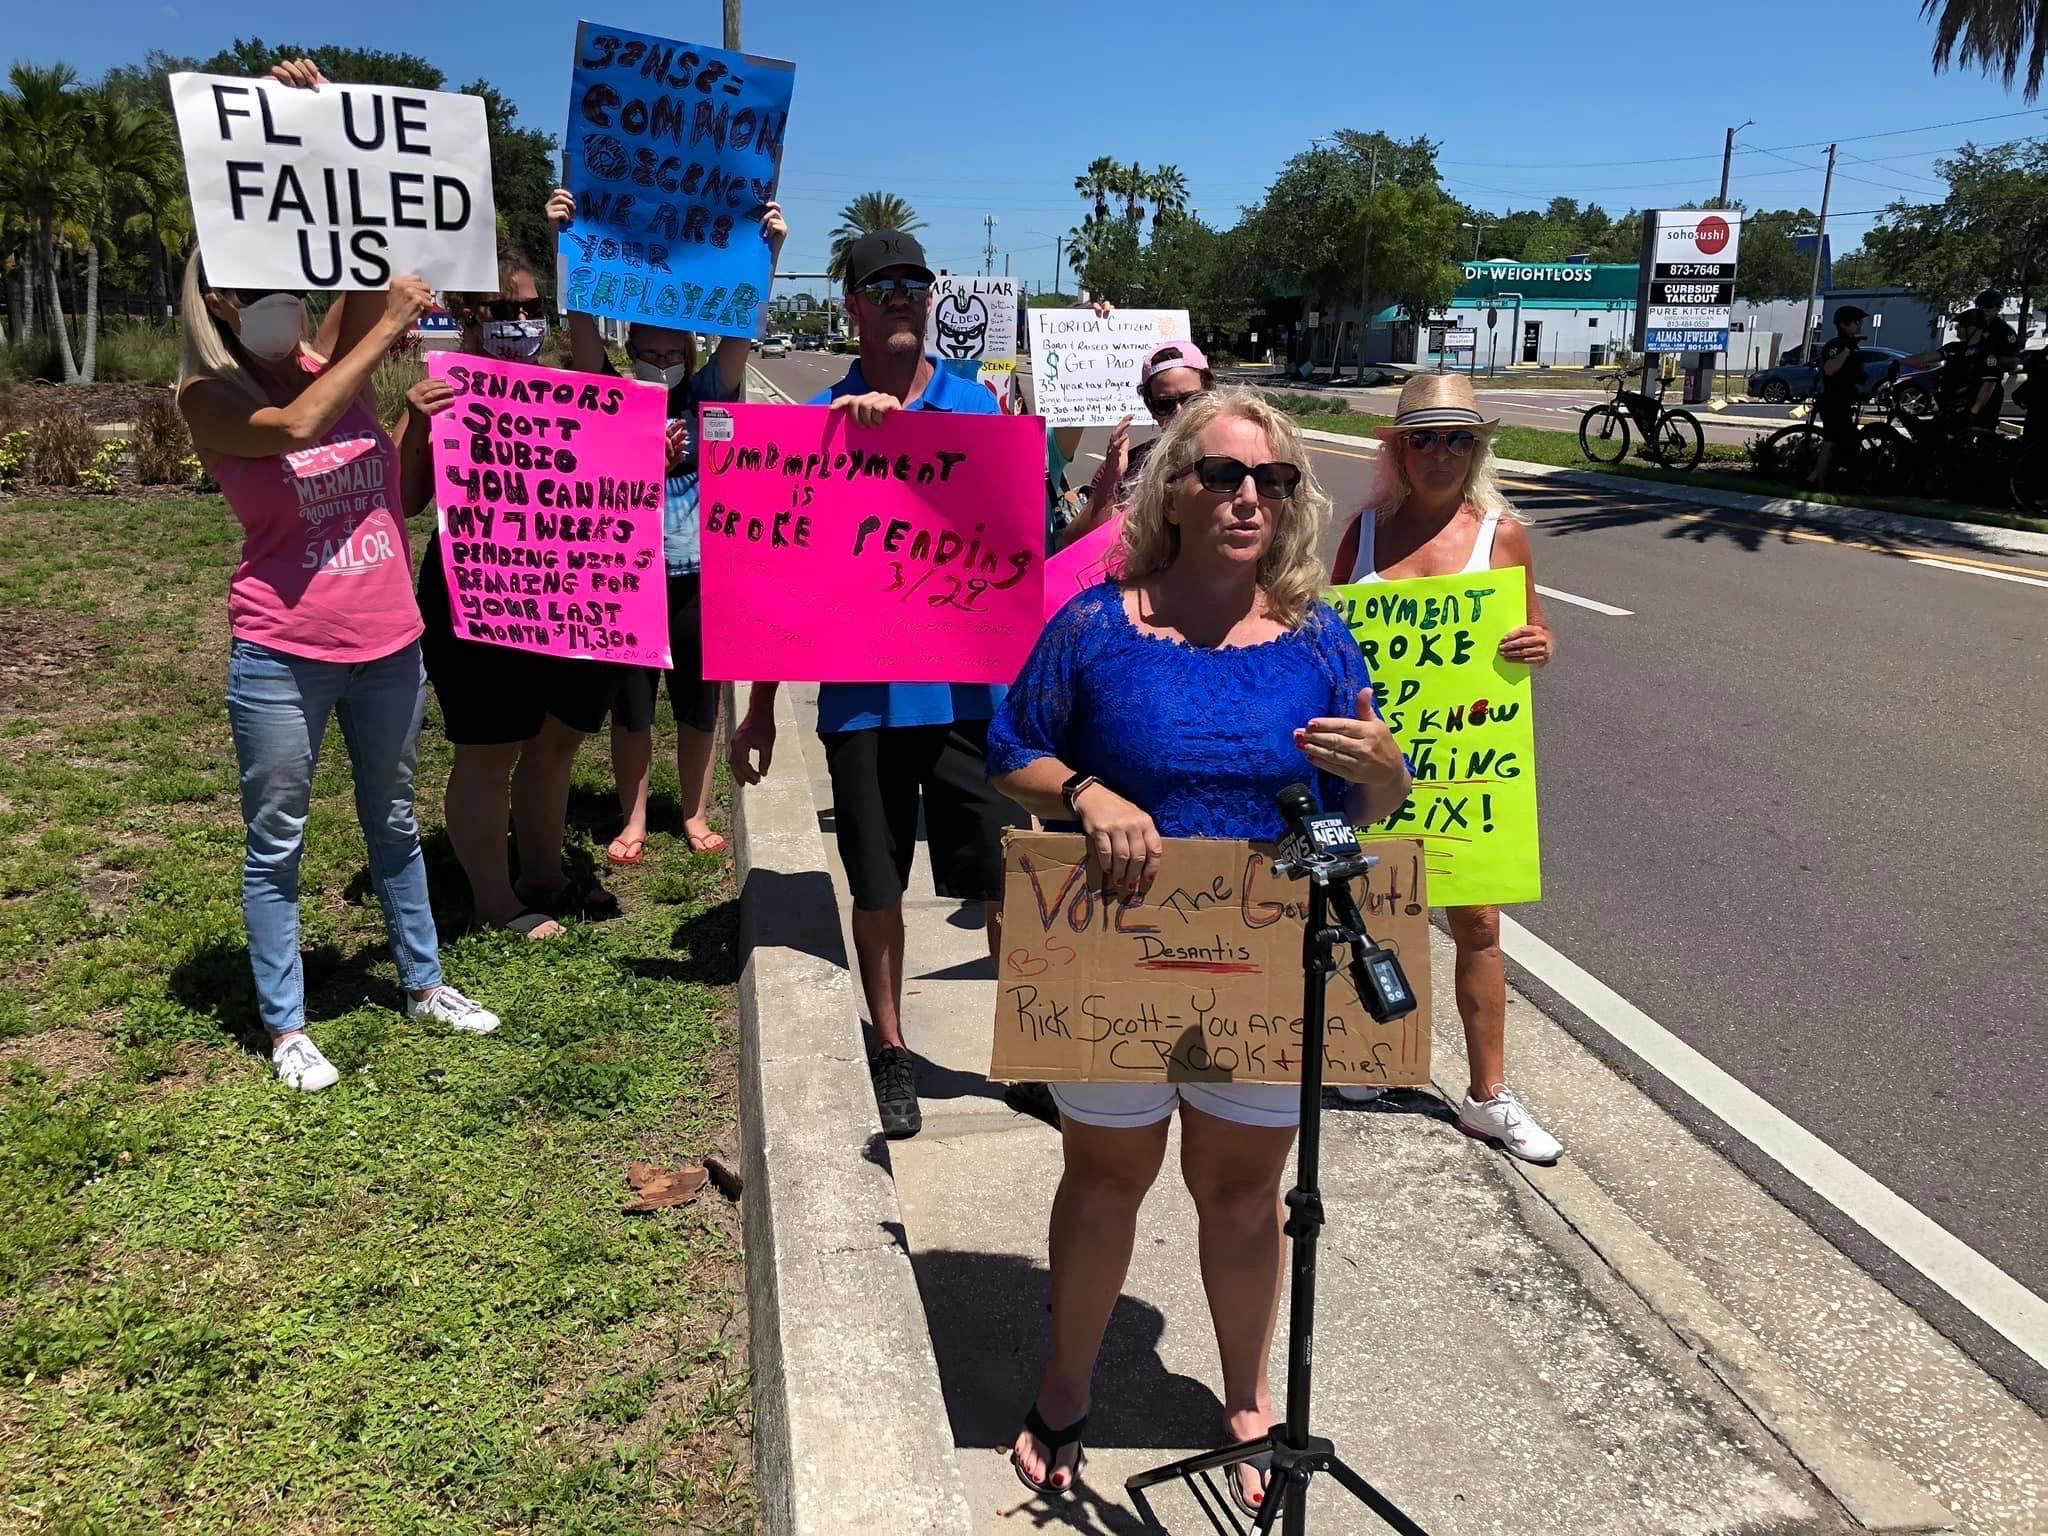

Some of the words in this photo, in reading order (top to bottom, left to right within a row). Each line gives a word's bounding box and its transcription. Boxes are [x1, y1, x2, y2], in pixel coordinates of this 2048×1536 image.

[212, 84, 302, 147] FL
[341, 90, 431, 156] UE
[582, 84, 789, 162] COMMON
[226, 160, 471, 232] FAILED
[580, 191, 633, 224] WE
[646, 202, 734, 249] ARE
[297, 228, 391, 287] US
[566, 228, 671, 274] YOUR
[1464, 267, 1592, 281] DI-WEIGHTLOSS
[1670, 264, 1720, 276] 873-7646
[566, 266, 760, 328] EMPLOYER
[973, 280, 1013, 296] LIAR
[1664, 284, 1720, 293] CURBSIDE
[1666, 294, 1717, 303] TAKEOUT
[1039, 313, 1100, 334] FLORIDA
[1107, 315, 1152, 332] CITIZEN
[1649, 307, 1678, 315] PURE
[1683, 307, 1730, 315] KITCHEN
[1655, 331, 1682, 342] ALMAS
[1683, 331, 1720, 342] JEWELRY
[1065, 353, 1097, 373] GET
[1105, 353, 1134, 369] PAID
[448, 366, 624, 414] SENATORS
[1038, 379, 1056, 392] 35
[462, 403, 581, 441] SCOTT
[470, 433, 577, 473] RUBIO
[293, 459, 383, 506] MERMAID
[446, 465, 529, 506] YOU
[537, 479, 593, 509] CAN
[598, 476, 662, 513] HAVE
[299, 499, 350, 526] MOUTH
[447, 505, 495, 540] MY
[502, 511, 527, 541] 7
[535, 512, 635, 543] WEEKS
[705, 502, 812, 549] BROKE
[302, 530, 395, 569] SAILOR
[452, 542, 559, 569] PENDING
[567, 551, 626, 570] WITH
[592, 572, 640, 594] FOR
[460, 594, 542, 621] YOUR
[548, 601, 624, 626] LAST
[468, 621, 549, 646] MONTH
[1313, 826, 1356, 846] NEWS
[1005, 985, 1071, 1042] Rick
[1190, 987, 1239, 1036] You
[1110, 1040, 1266, 1073] CROOK
